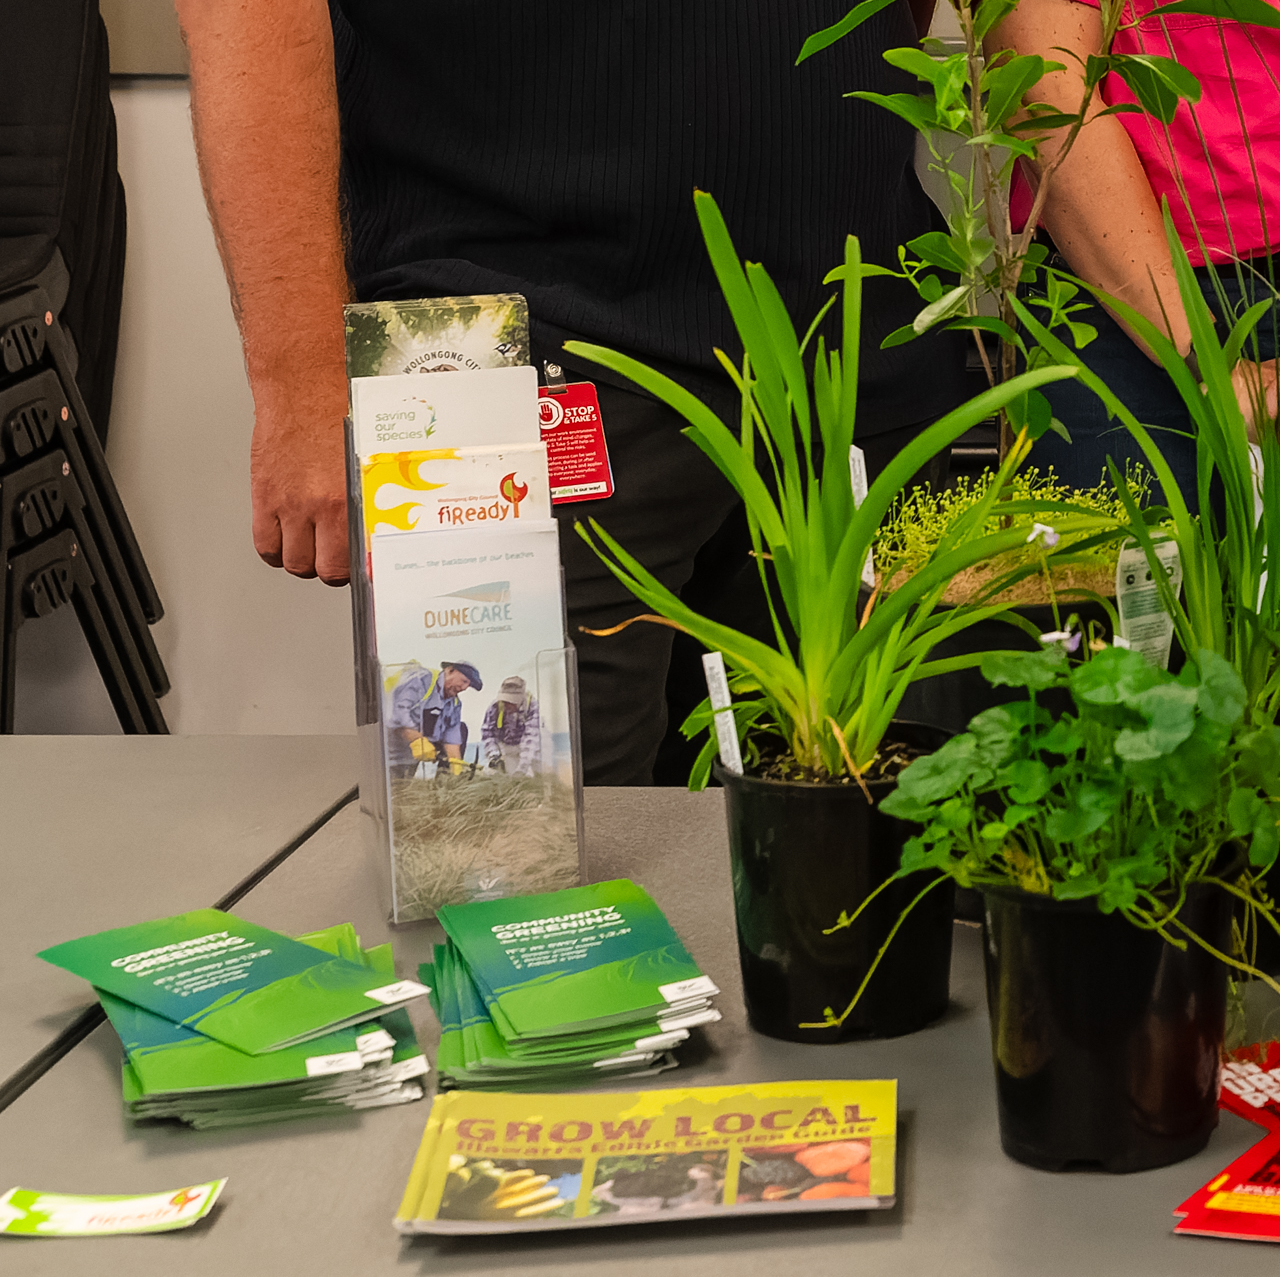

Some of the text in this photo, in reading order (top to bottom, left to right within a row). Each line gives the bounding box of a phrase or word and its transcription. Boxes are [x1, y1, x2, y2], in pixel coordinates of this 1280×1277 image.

[402, 350, 482, 375] WOLLONGONG CIT
[374, 411, 416, 422] saving
[564, 405, 595, 418] STOP
[570, 415, 591, 424] TAKE
[374, 423, 397, 432] our
[376, 429, 424, 443] species
[437, 501, 510, 526] fiReady
[423, 602, 514, 630] DUNECARE
[491, 905, 616, 933] COMMUNITY
[495, 912, 622, 940] GREENING
[454, 1103, 879, 1145] GROW LOCAL
[455, 1138, 586, 1158] Illawarra
[683, 1129, 784, 1148] Garden
[792, 1123, 873, 1140] Guide
